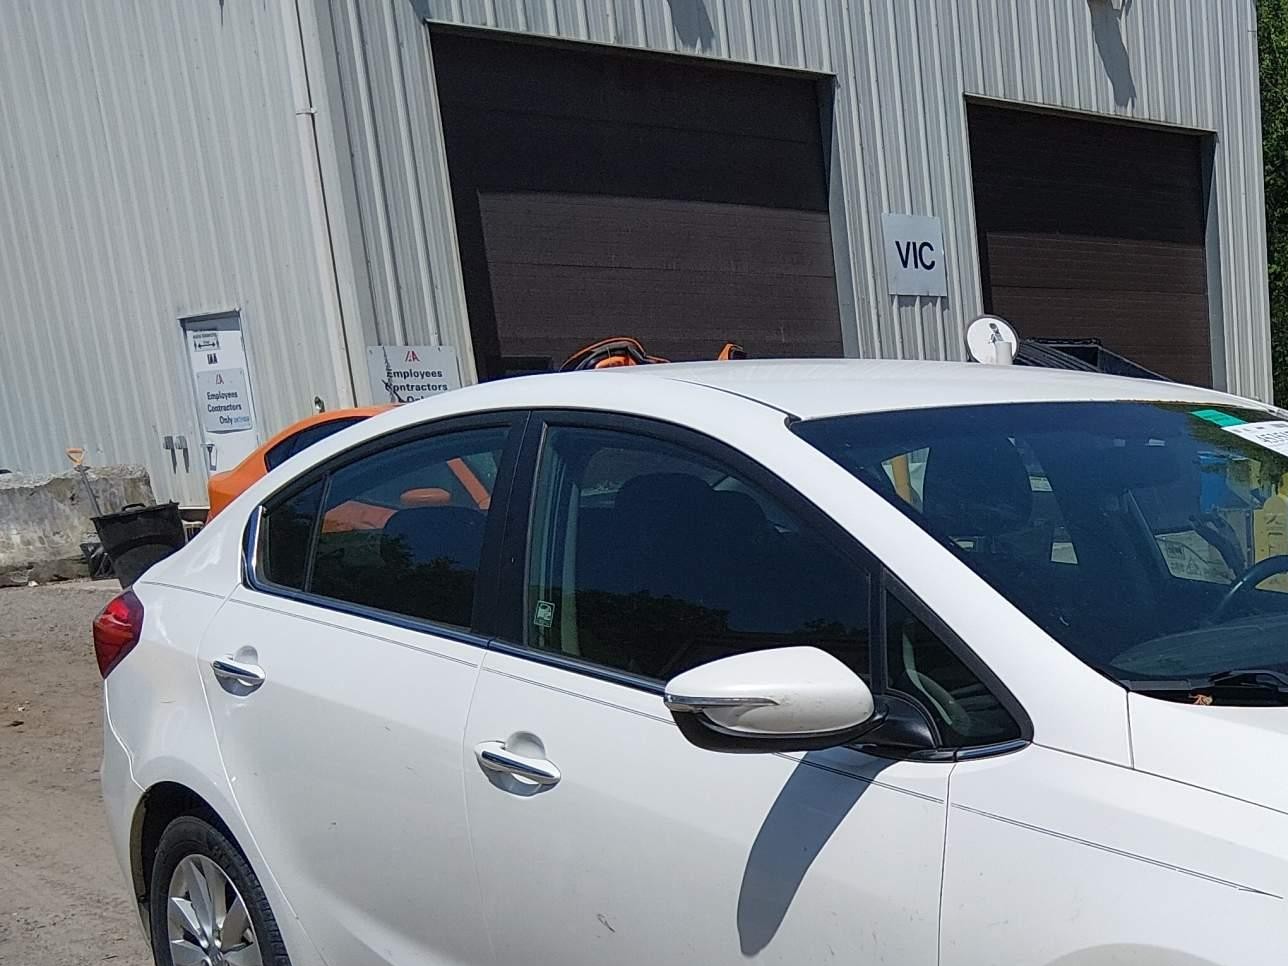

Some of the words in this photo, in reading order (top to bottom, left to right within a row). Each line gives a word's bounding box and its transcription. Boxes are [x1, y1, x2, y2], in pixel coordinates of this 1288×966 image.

[894, 240, 936, 271] VIC
[386, 369, 443, 379] Employees
[384, 383, 449, 392] Contractors
[206, 391, 238, 401] Employees
[207, 403, 243, 413] Contractors
[219, 415, 233, 425] Only
